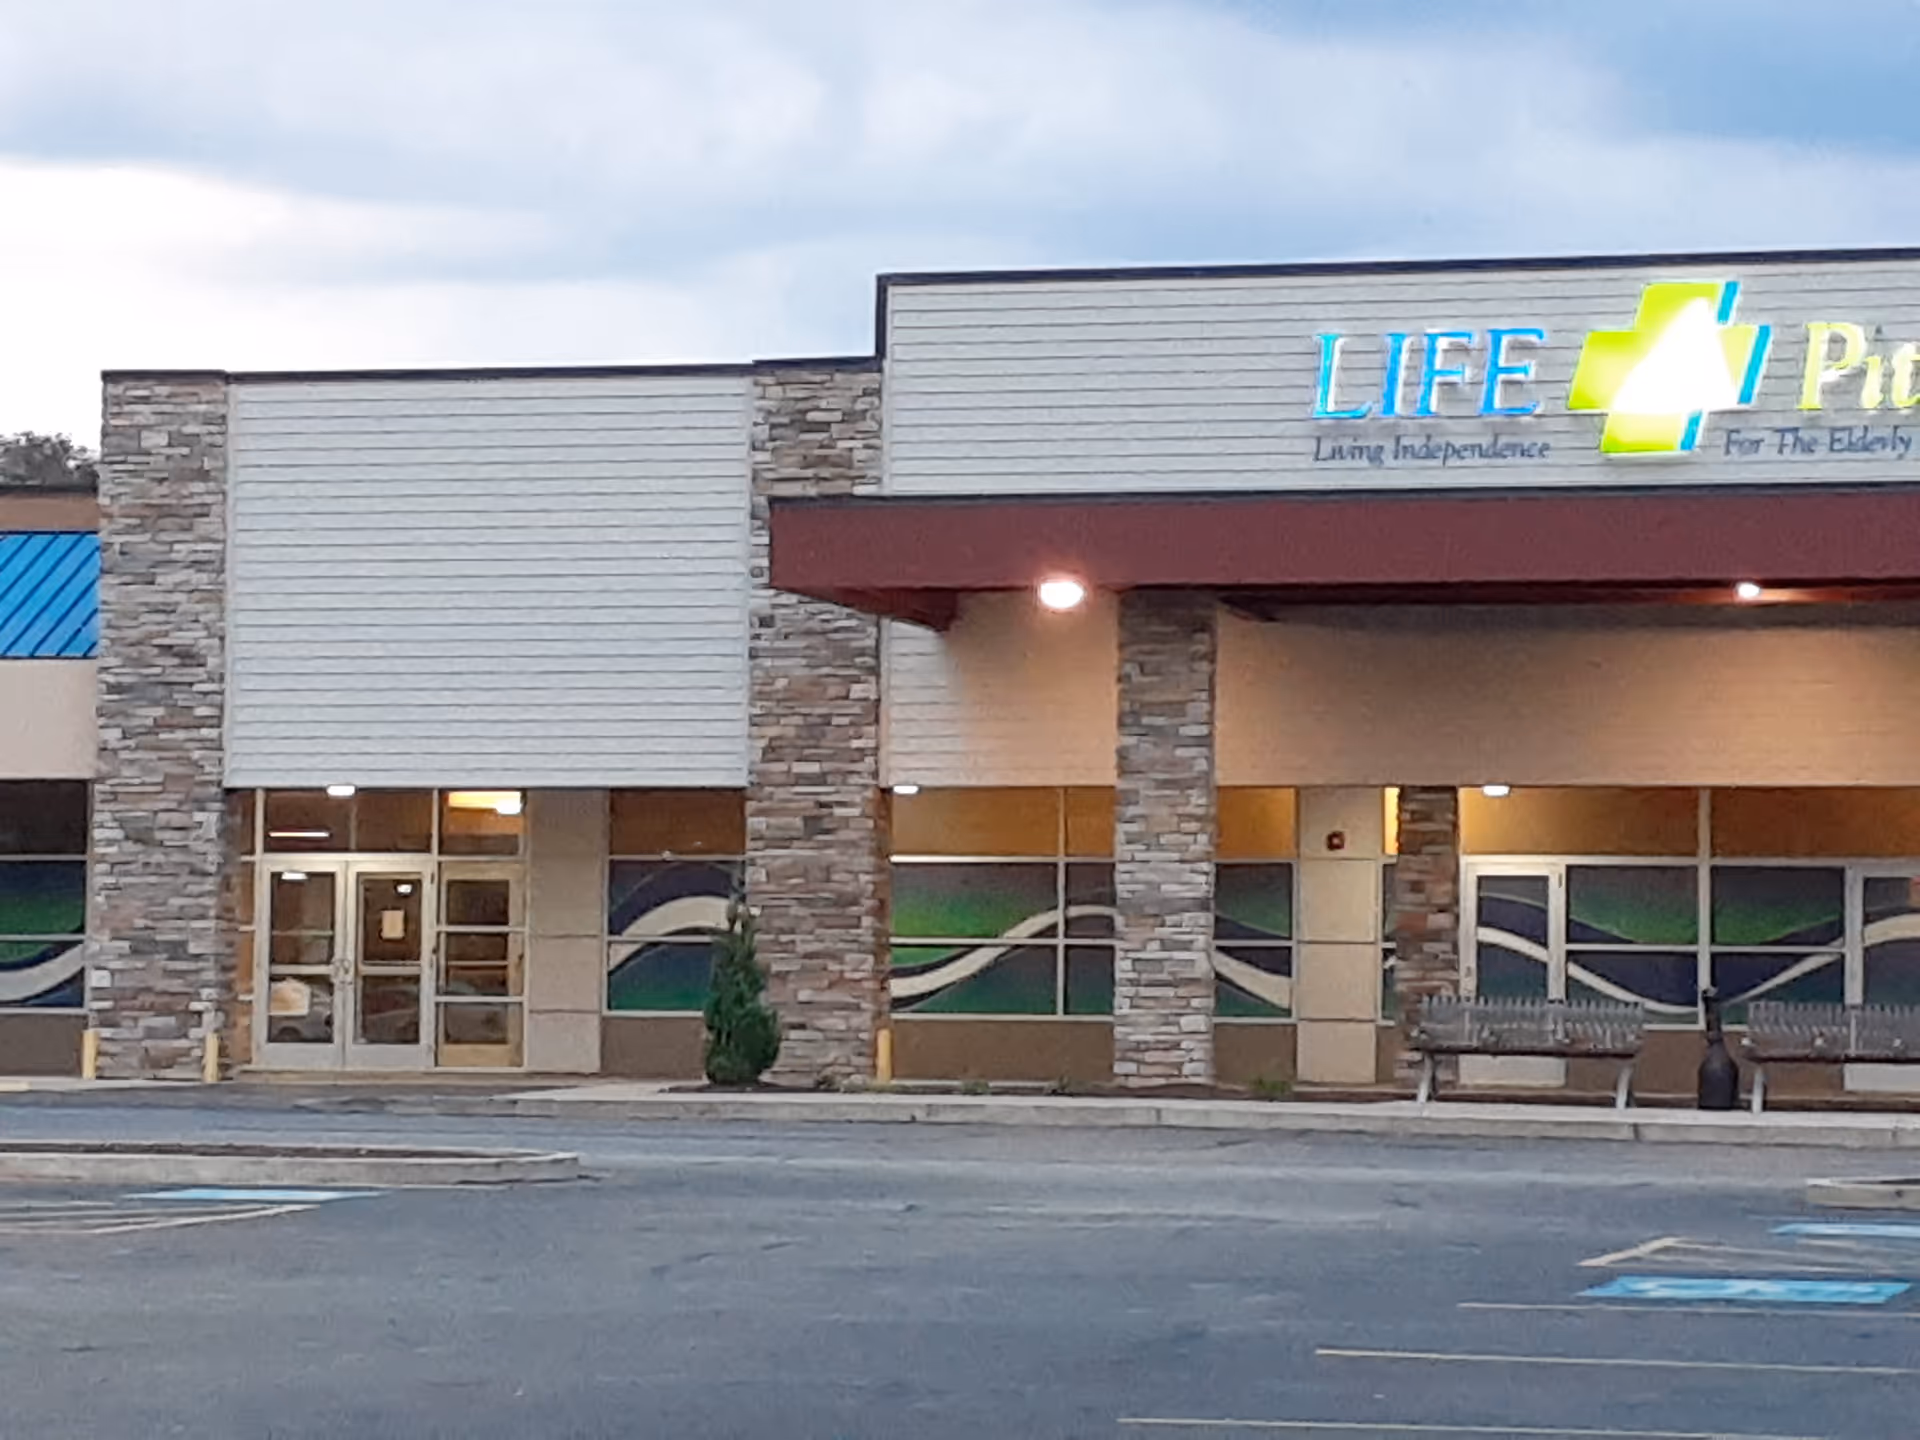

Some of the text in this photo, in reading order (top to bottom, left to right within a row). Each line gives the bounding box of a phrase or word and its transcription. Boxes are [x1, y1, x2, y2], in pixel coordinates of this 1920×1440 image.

[1312, 328, 1546, 419] LIFE
[1313, 434, 1551, 467] Living Independence
[1724, 424, 1913, 460] For The Elderly
